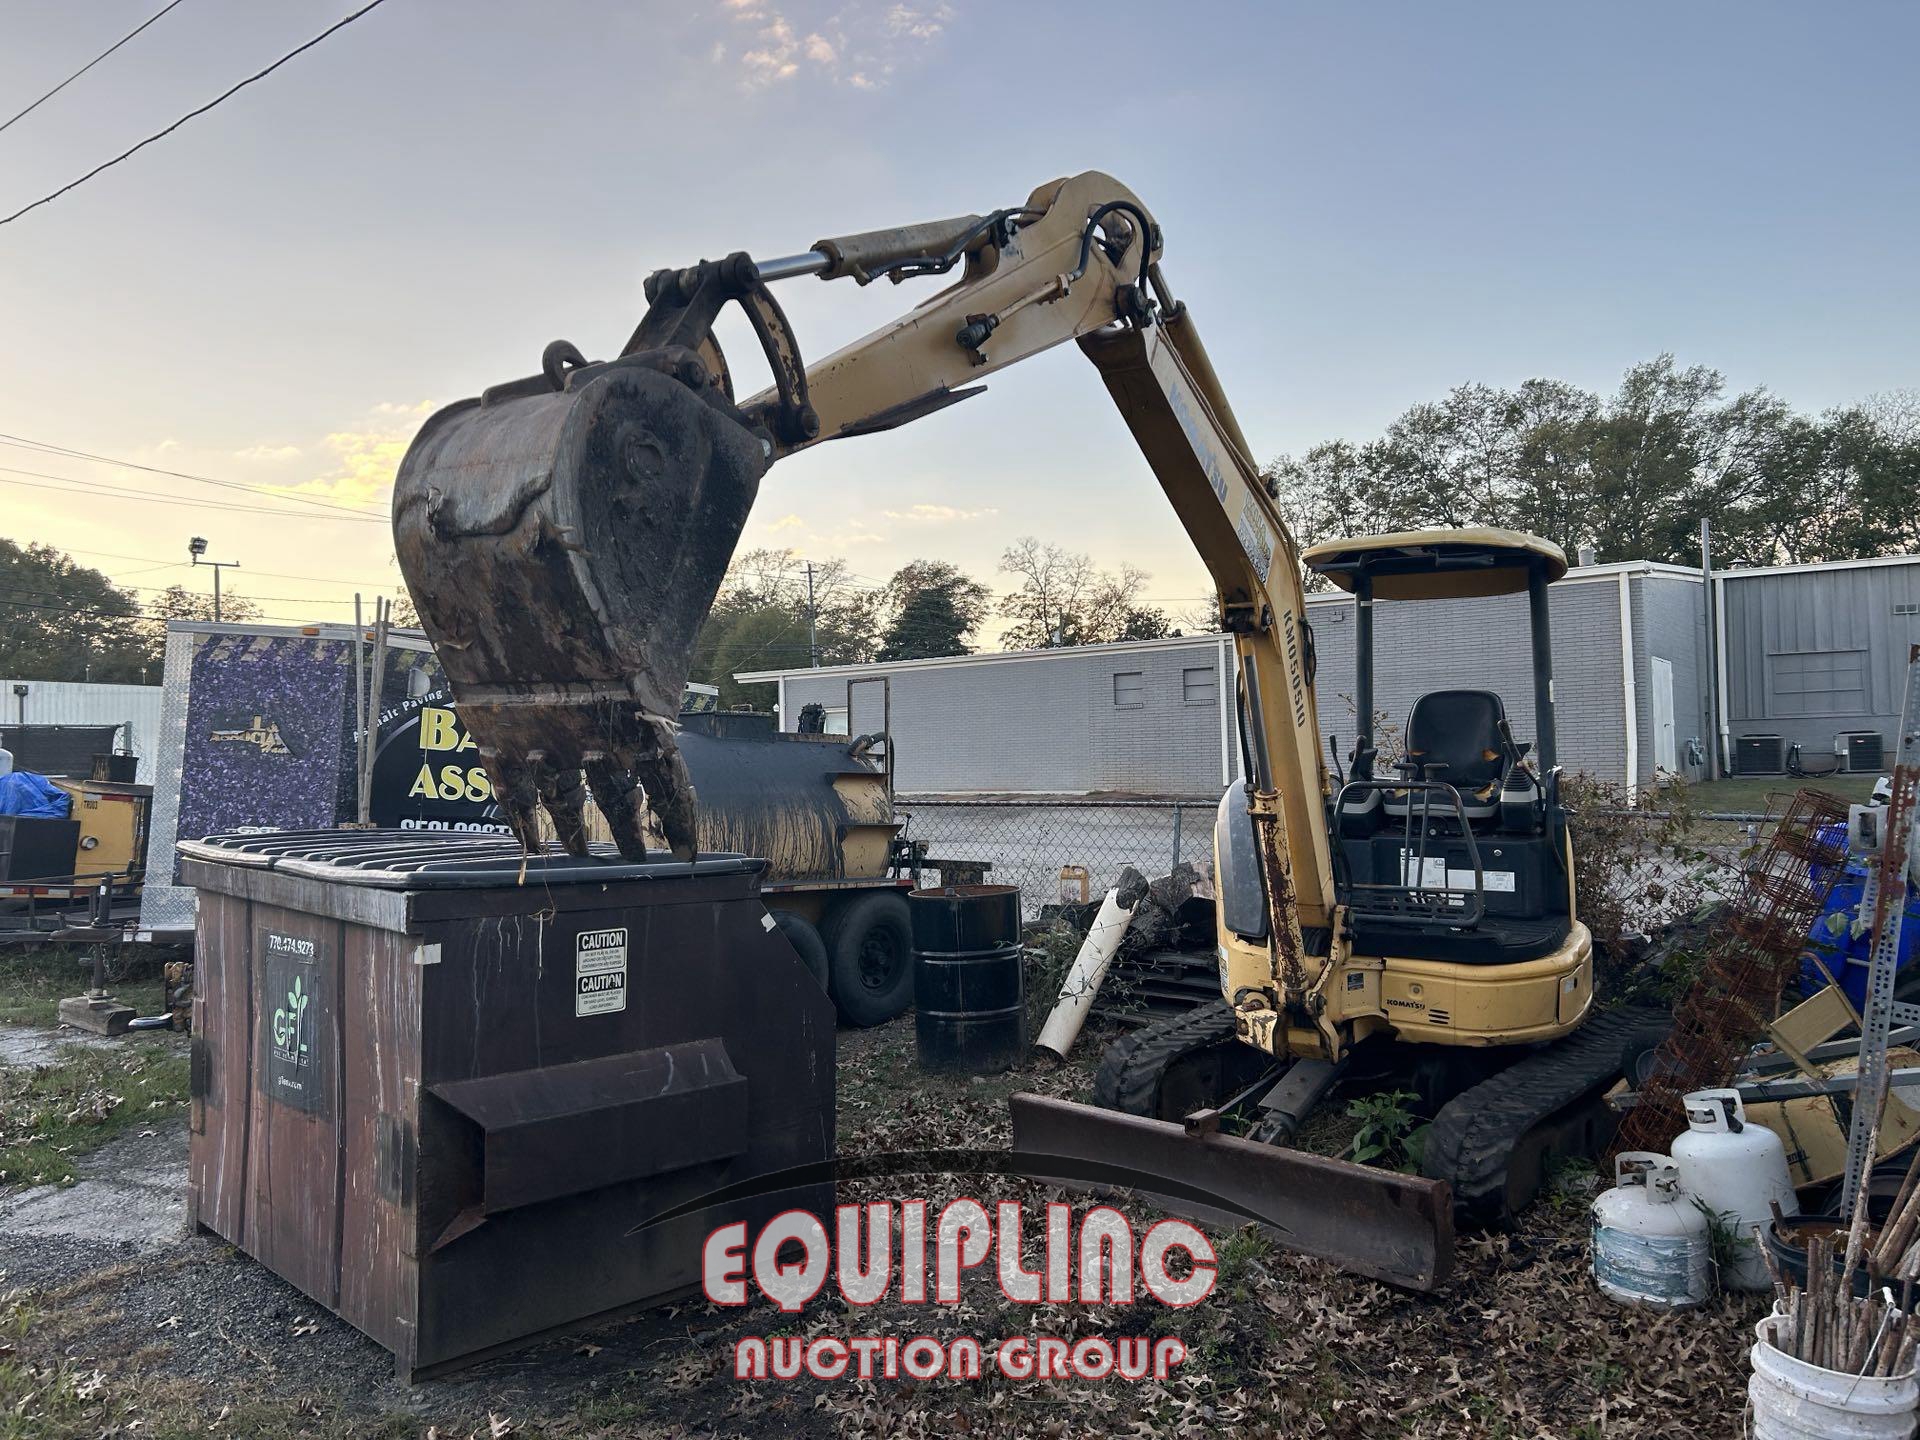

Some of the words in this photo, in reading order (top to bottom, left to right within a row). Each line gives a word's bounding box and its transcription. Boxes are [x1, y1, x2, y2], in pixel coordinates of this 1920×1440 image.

[402, 689, 443, 711] Paving
[582, 932, 623, 950] CAUTION
[581, 973, 622, 992] CAUTION
[1386, 999, 1426, 1010] KOMATSU
